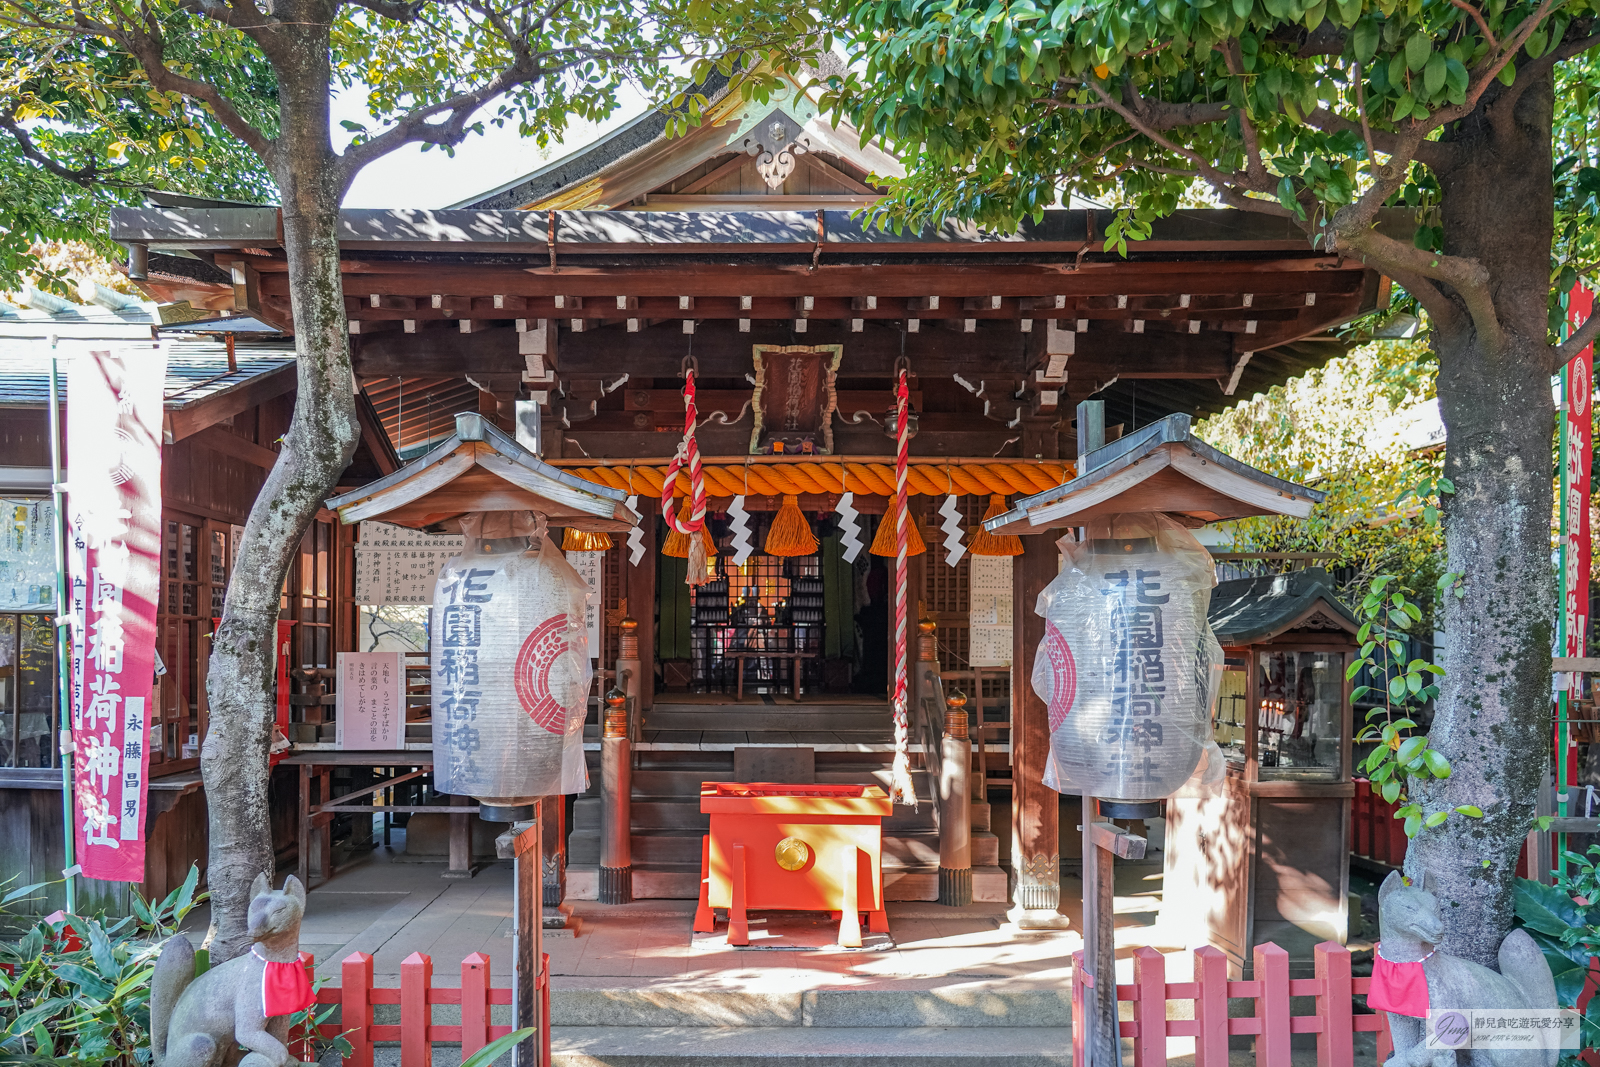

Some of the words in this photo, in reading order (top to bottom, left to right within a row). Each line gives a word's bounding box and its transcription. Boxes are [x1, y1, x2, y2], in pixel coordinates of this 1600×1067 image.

[373, 552, 381, 583] 御神酒料
[358, 662, 366, 713] きはめてしがな
[382, 662, 390, 685] 天地も
[370, 698, 378, 742] まことの道を
[123, 713, 144, 819] 永藤昌男
